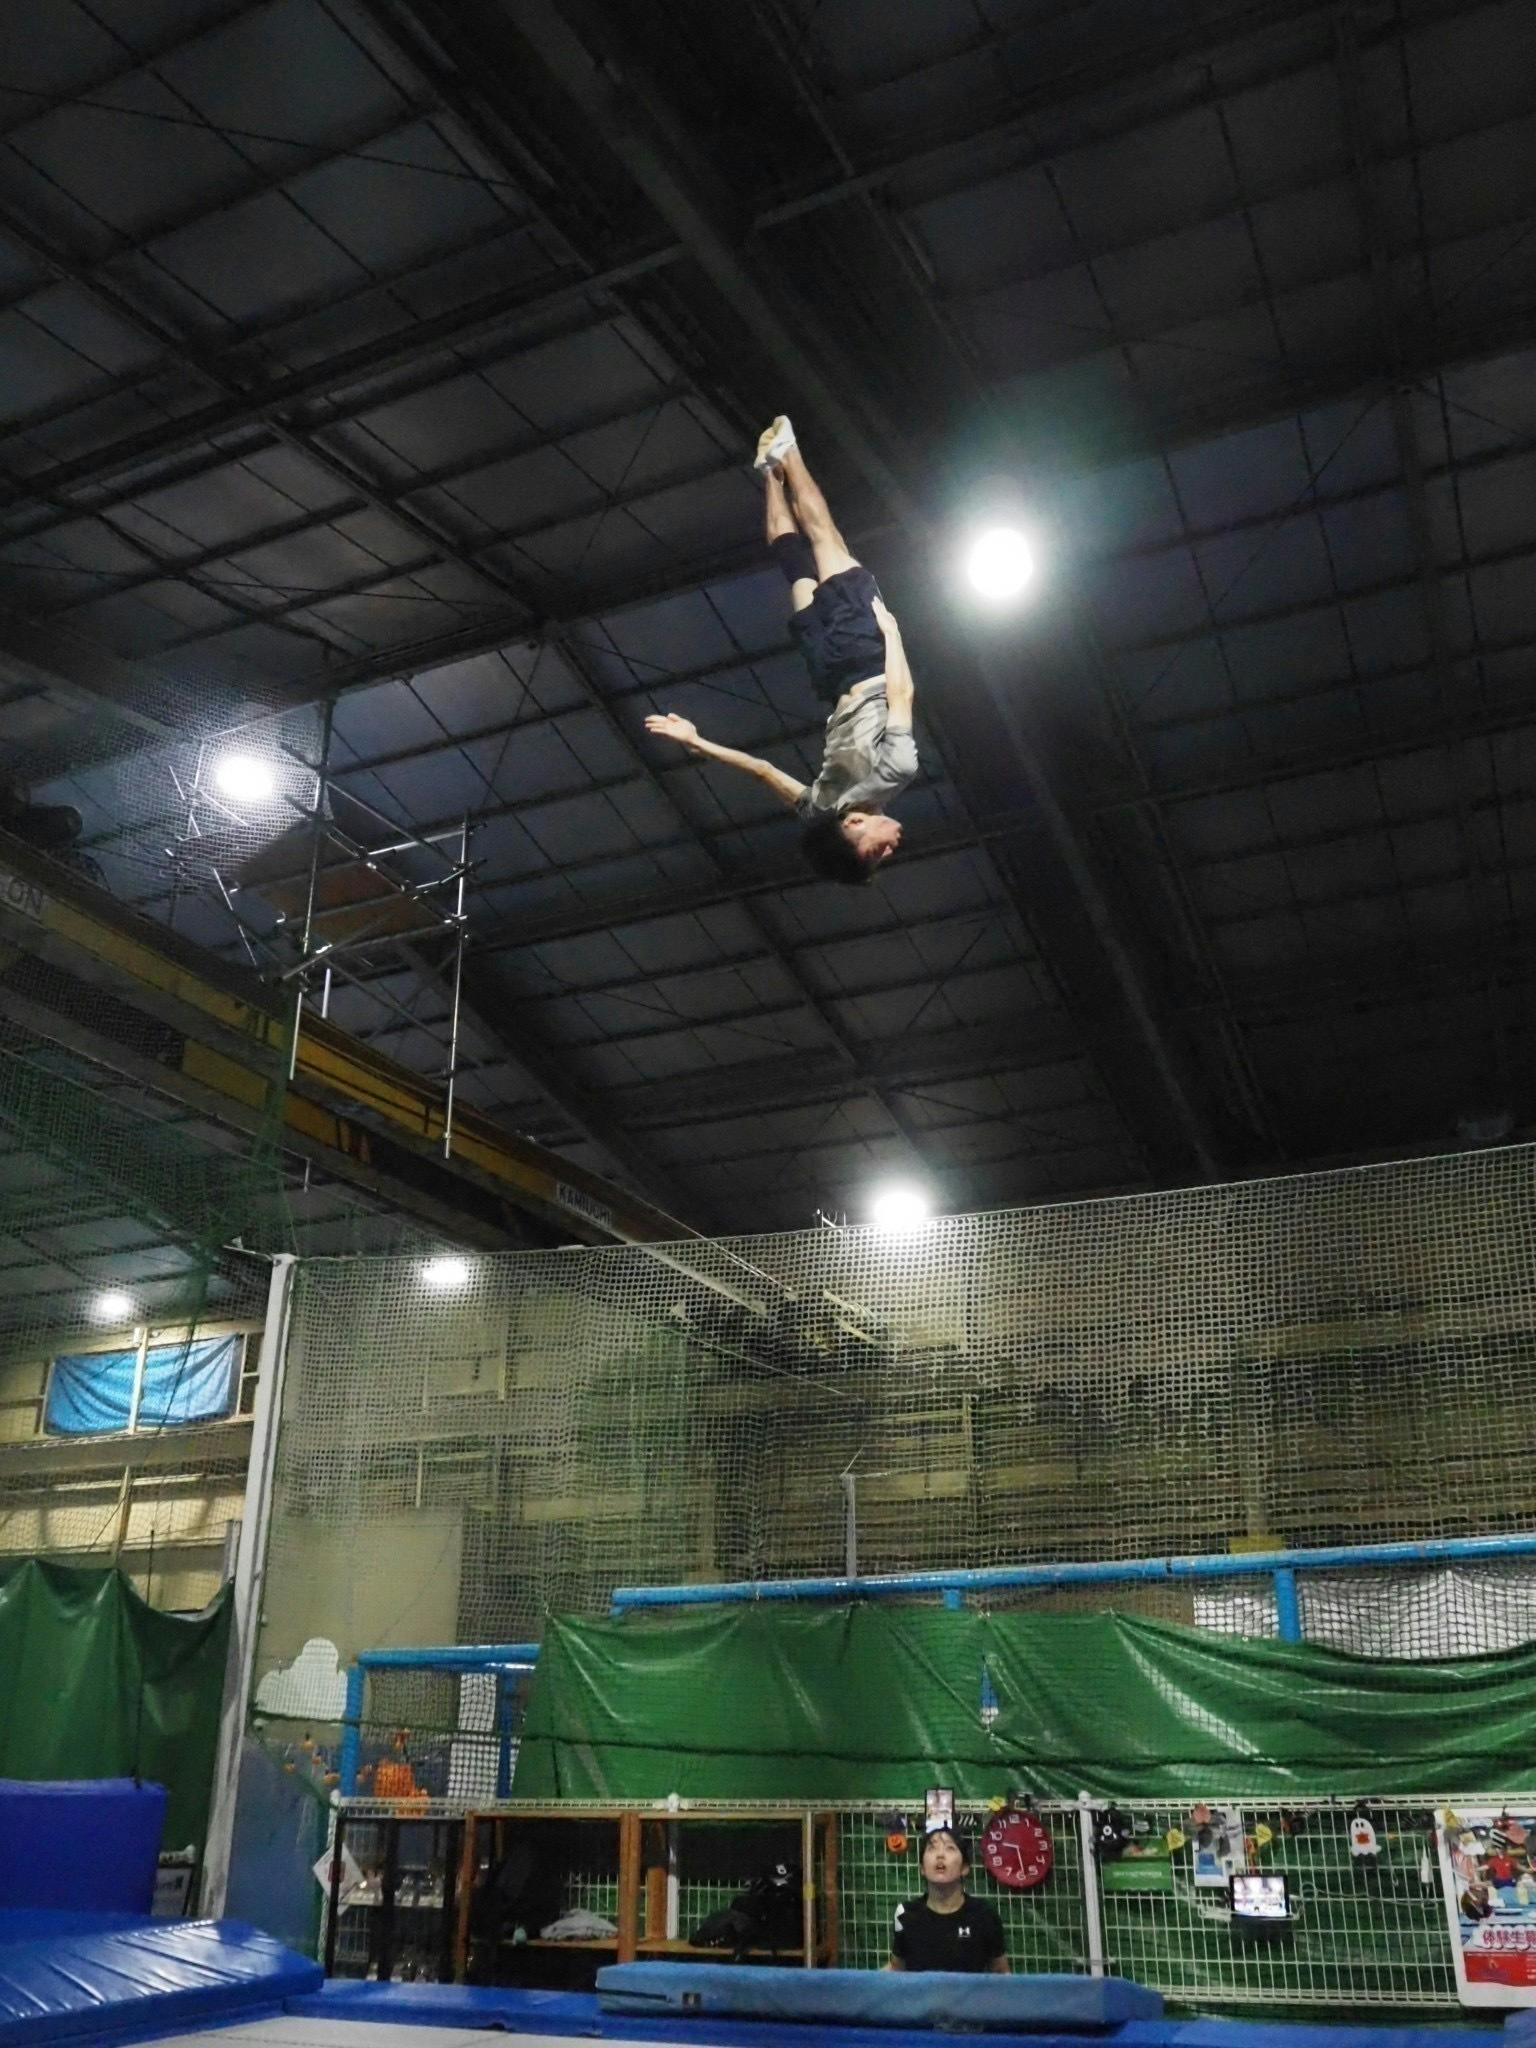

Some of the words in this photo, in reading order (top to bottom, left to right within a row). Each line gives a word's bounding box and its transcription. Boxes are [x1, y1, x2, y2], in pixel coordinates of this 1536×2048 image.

[989, 1831, 1003, 1841] 10
[1034, 1828, 1043, 1837] 2
[987, 1844, 997, 1854] 9
[1038, 1840, 1048, 1851] 3
[992, 1856, 1003, 1867] 8
[1036, 1855, 1046, 1865] 4
[1005, 1866, 1013, 1876] 7
[1028, 1865, 1039, 1876] 5
